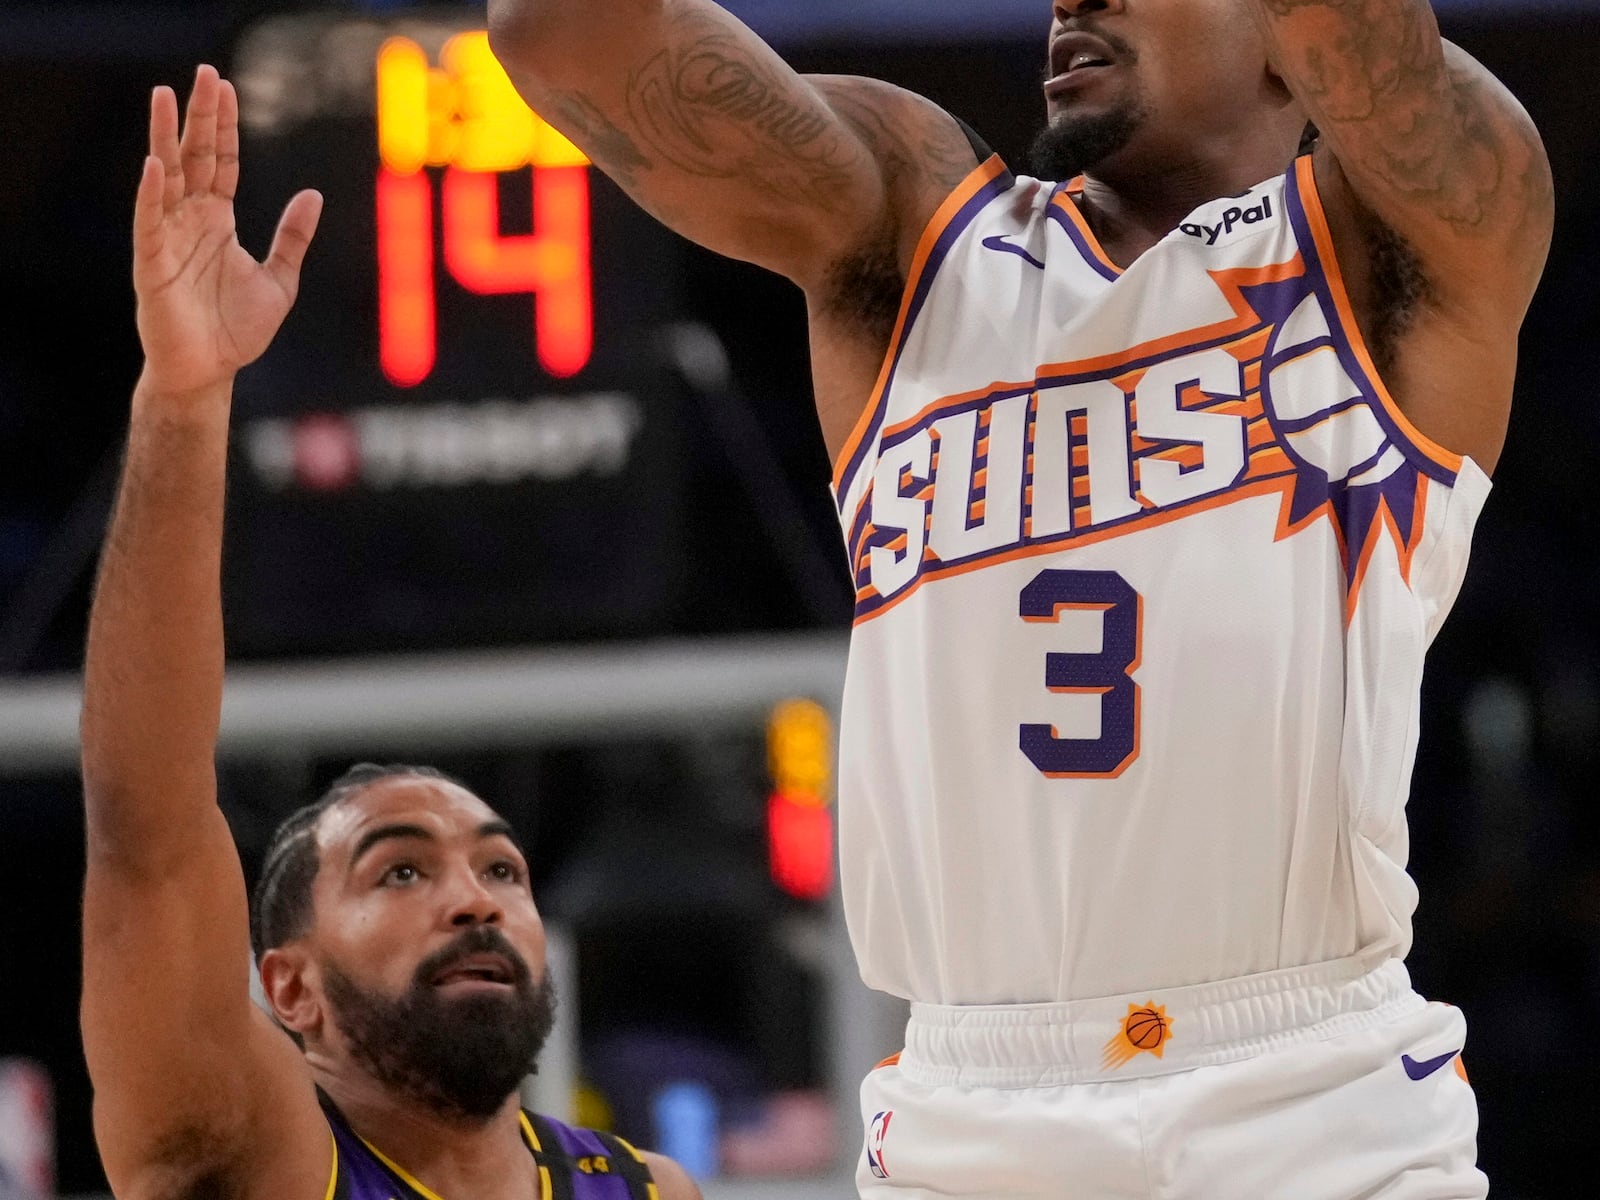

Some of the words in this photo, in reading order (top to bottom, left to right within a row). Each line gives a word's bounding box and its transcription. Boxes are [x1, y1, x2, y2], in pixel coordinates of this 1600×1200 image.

[376, 162, 594, 388] 14
[1179, 195, 1273, 246] ayPal
[868, 346, 1250, 599] SUNS
[1019, 568, 1144, 779] 3
